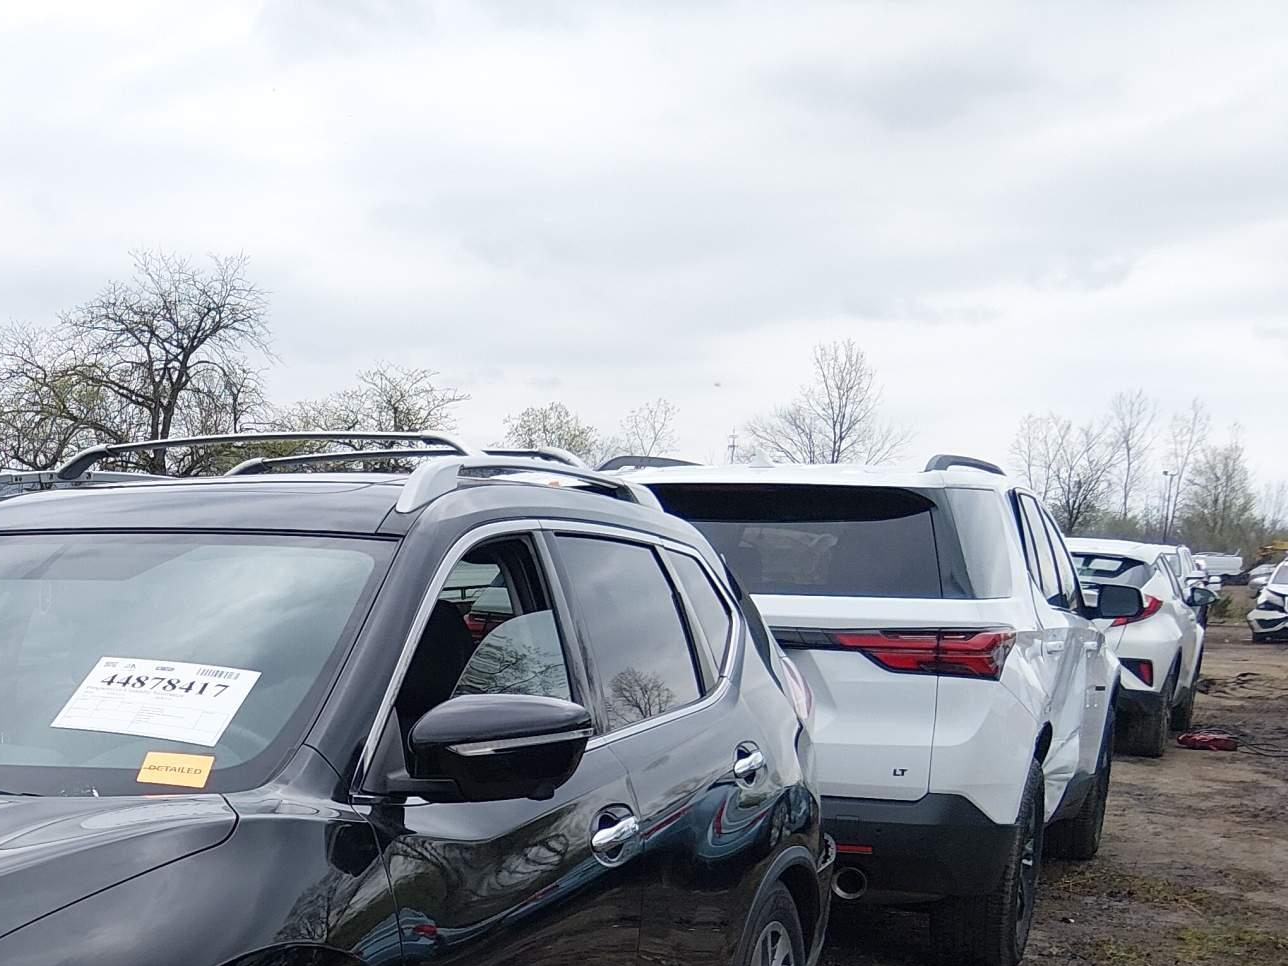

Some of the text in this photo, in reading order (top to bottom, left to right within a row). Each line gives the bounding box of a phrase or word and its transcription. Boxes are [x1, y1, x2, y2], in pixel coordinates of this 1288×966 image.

[100, 673, 230, 698] 44878417
[147, 764, 202, 775] DETAILED
[893, 768, 908, 776] LT
